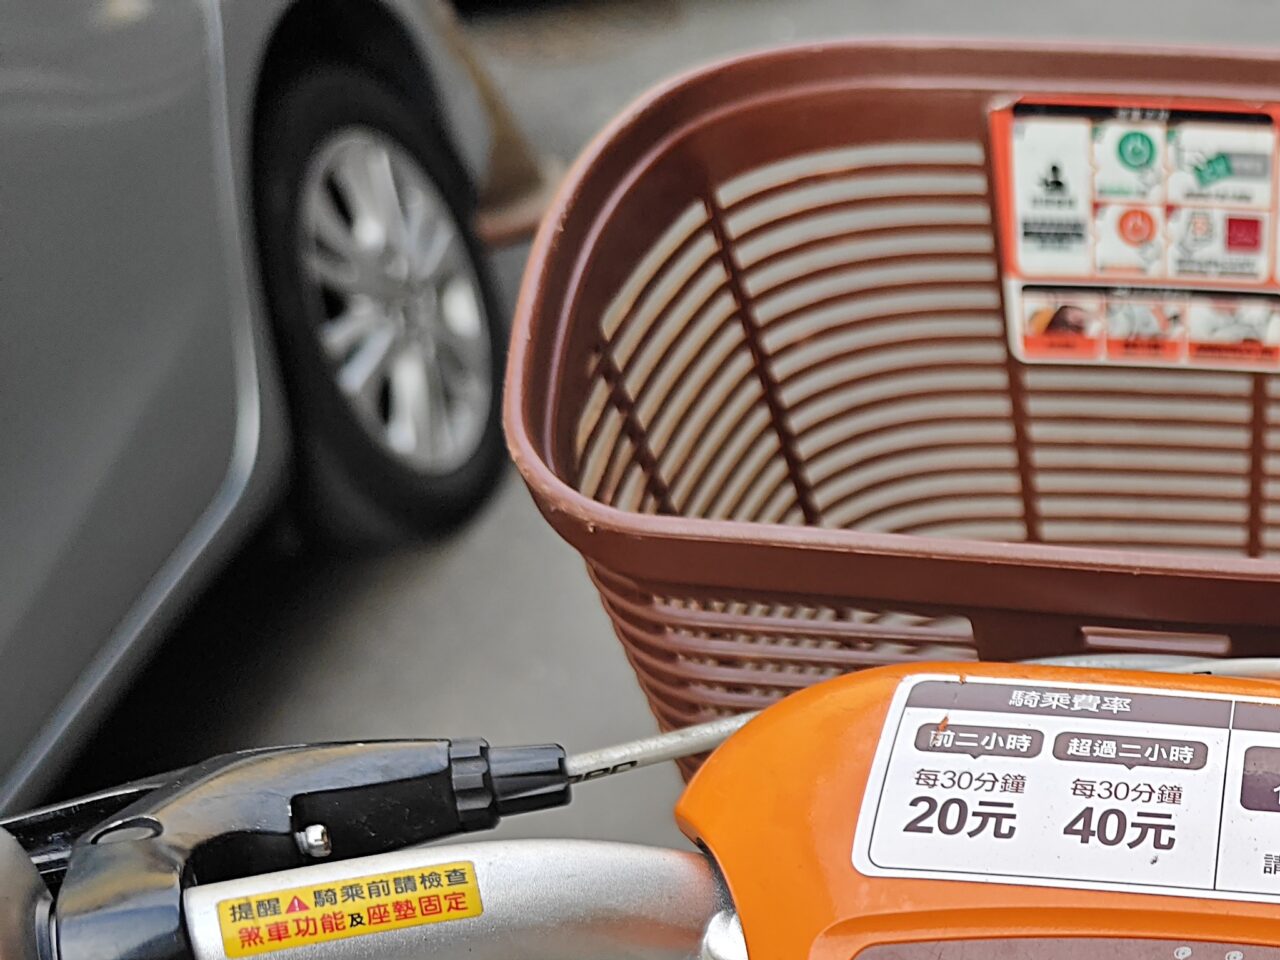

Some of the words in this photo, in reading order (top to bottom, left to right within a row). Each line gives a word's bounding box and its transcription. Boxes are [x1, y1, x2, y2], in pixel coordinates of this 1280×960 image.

[1009, 689, 1132, 714] 騎乘費率
[929, 730, 1032, 752] 前二小時
[1066, 738, 1194, 764] 超過二小時
[914, 768, 1027, 794] 每30分鐘
[1070, 778, 1183, 805] 每30分鐘
[902, 795, 1017, 839] 20元
[1062, 806, 1176, 851] 40元
[229, 897, 282, 923] 提醒
[313, 868, 469, 909] 騎乘前請檢查
